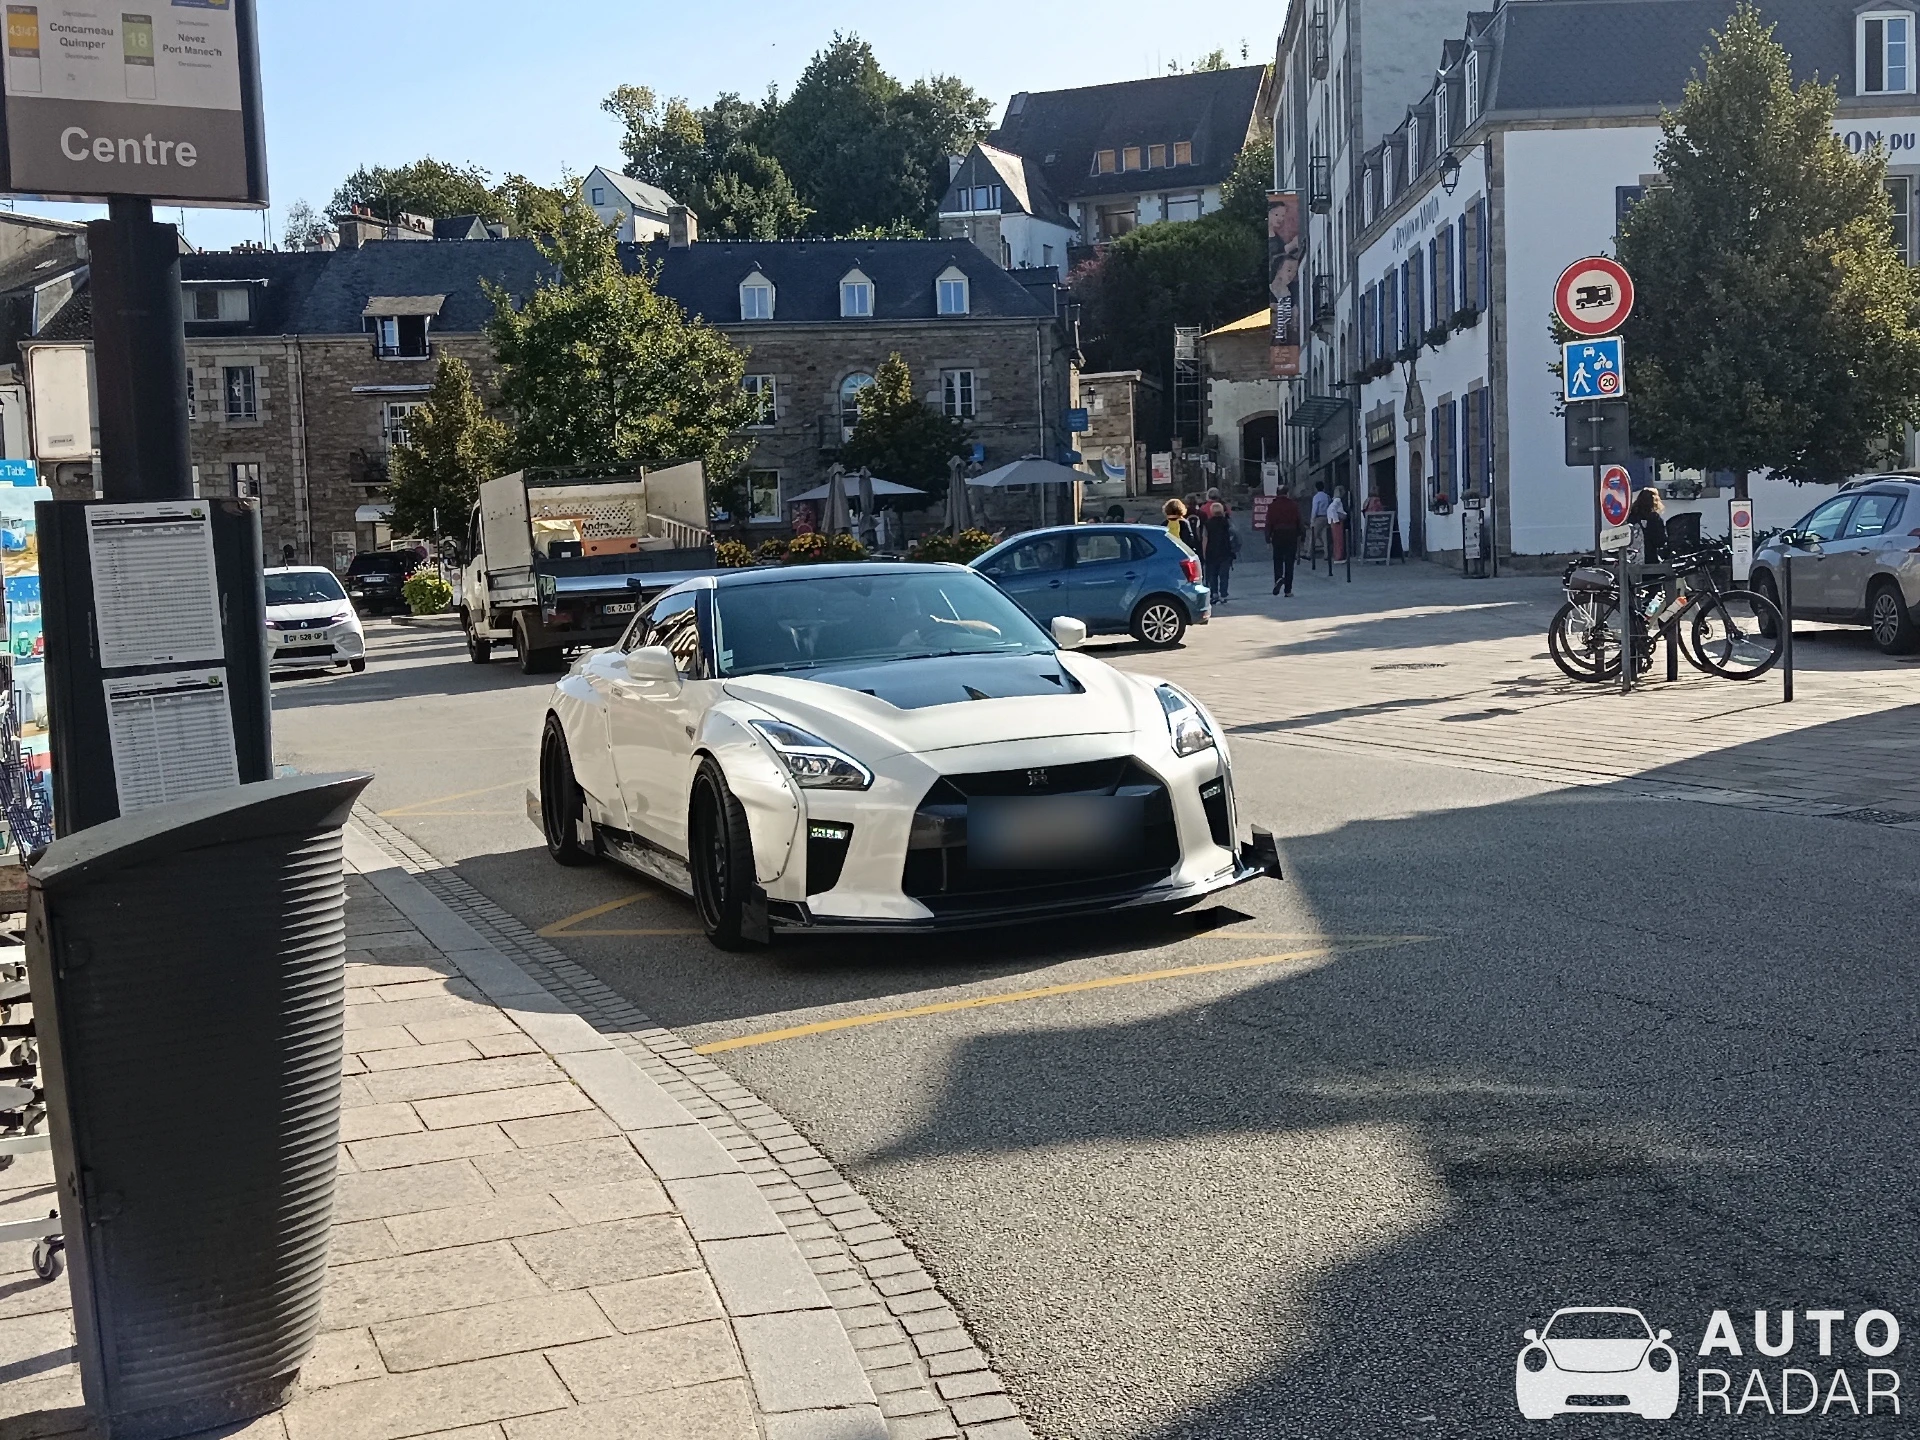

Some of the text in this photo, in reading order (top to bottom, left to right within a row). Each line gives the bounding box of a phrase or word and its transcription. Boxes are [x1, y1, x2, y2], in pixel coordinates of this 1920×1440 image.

[49, 22, 114, 36] Concarneau
[59, 37, 106, 50] Quimper
[128, 32, 148, 48] 18
[162, 44, 222, 57] Port Manec'h
[60, 126, 197, 167] Centre
[1890, 133, 1915, 150] DU
[1603, 378, 1614, 387] 20
[5, 464, 26, 477] Table
